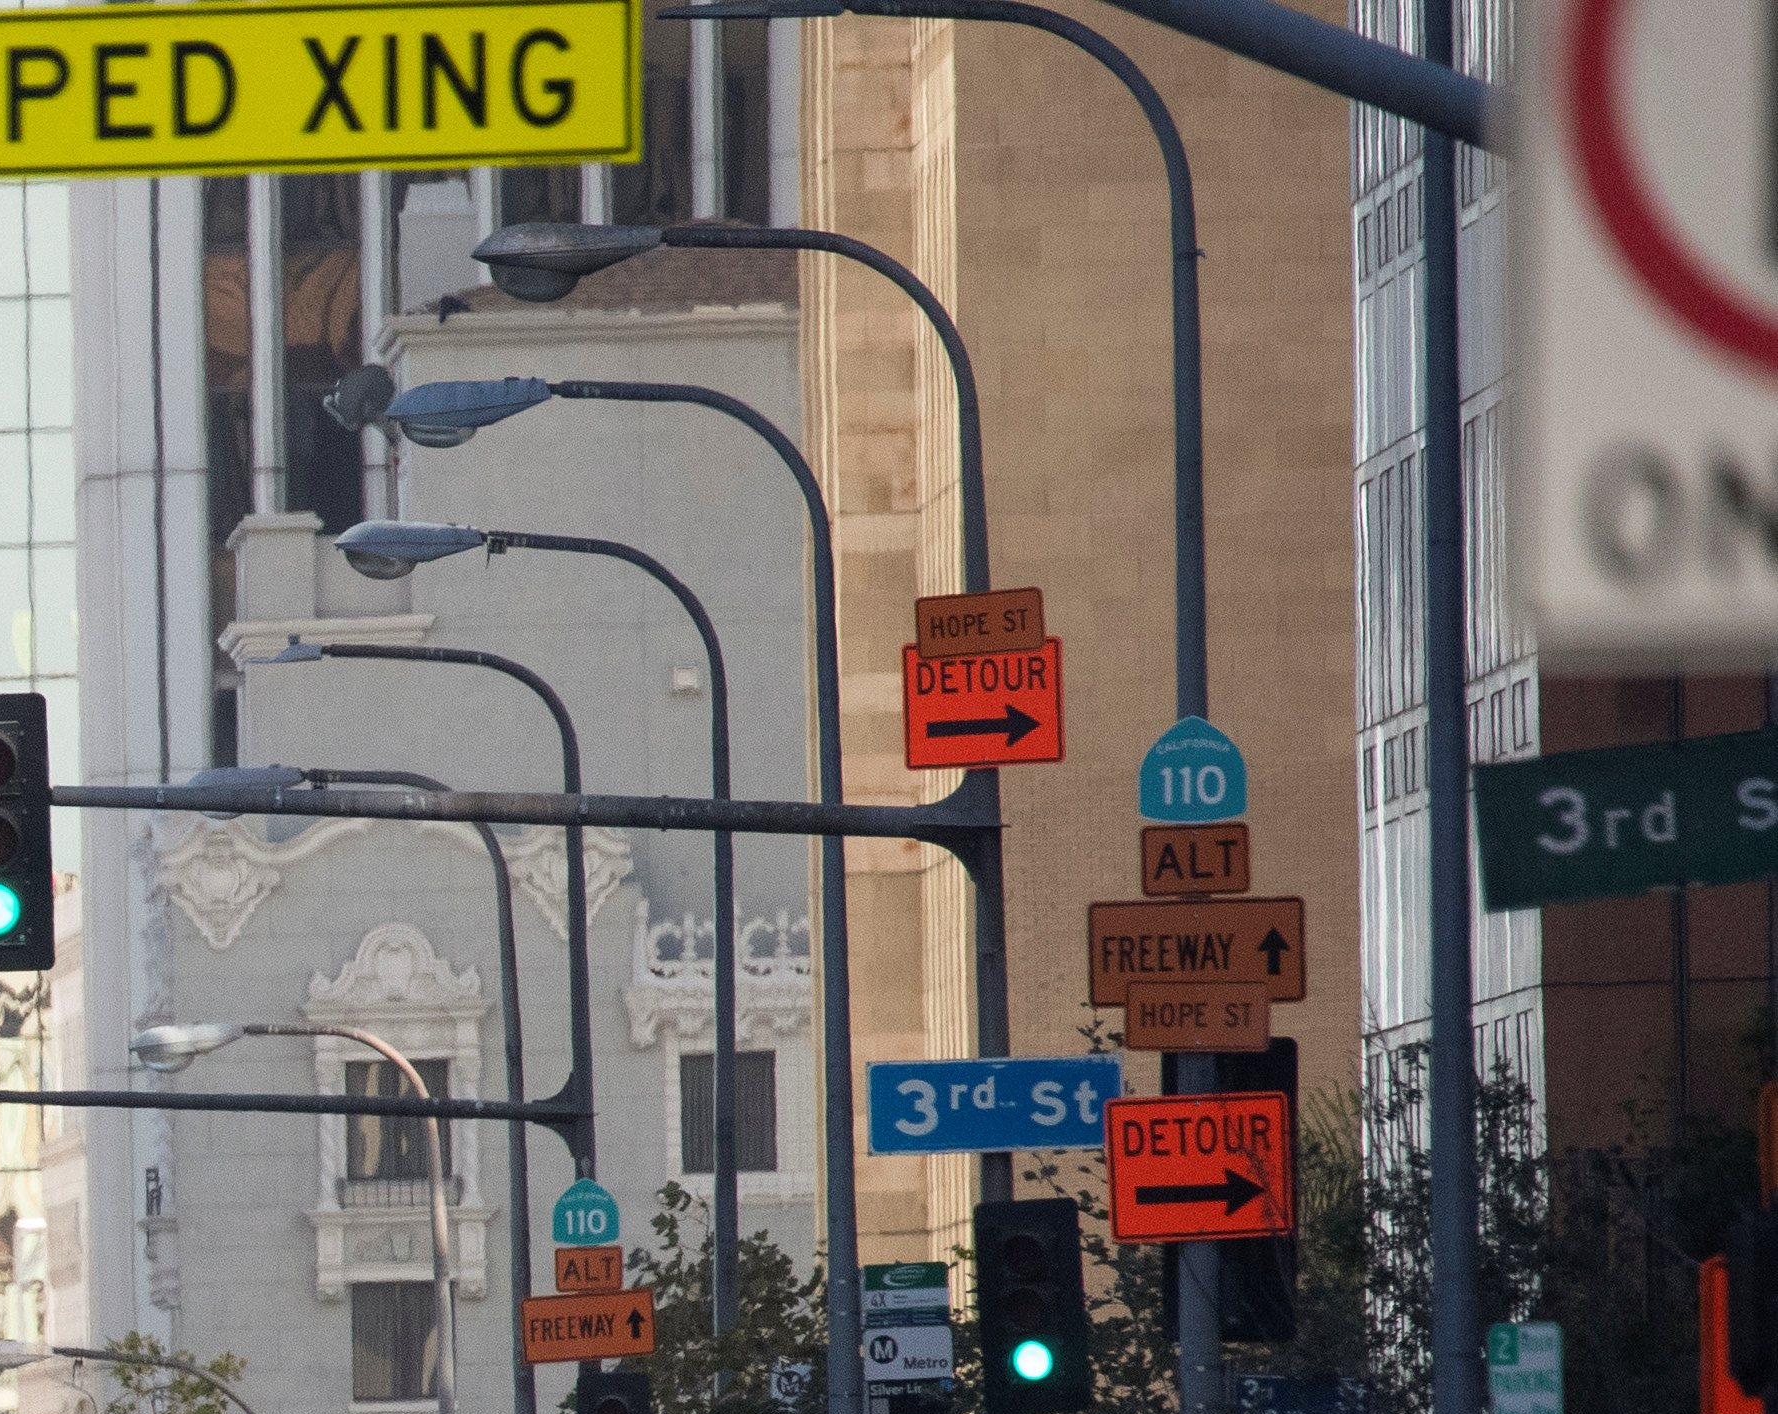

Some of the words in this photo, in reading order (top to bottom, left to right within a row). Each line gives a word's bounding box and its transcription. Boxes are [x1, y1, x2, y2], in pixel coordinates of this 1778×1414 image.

[6, 41, 237, 143] PED
[301, 27, 578, 134] XING
[930, 612, 990, 638] HOPE
[1003, 608, 1028, 633] ST
[916, 656, 1047, 695] DETOUR
[1154, 738, 1230, 755] CALIFORNIA
[1159, 765, 1227, 805] 110
[1537, 786, 1677, 854] 3rd
[1154, 839, 1238, 880] ALT
[1101, 933, 1235, 973] FREEWAY
[1140, 1002, 1208, 1028] HOPE
[1224, 1002, 1251, 1028] ST
[894, 1076, 996, 1136] 3rd
[1030, 1080, 1099, 1126] St
[1122, 1114, 1272, 1157] DETOUR
[565, 1208, 608, 1236] 110
[562, 1256, 615, 1283] ALT
[871, 1291, 887, 1307] 4X
[530, 1313, 615, 1342] FREEWAY
[1498, 1332, 1510, 1360] 2
[903, 1356, 949, 1370] Metro
[870, 1384, 905, 1397] Silver
